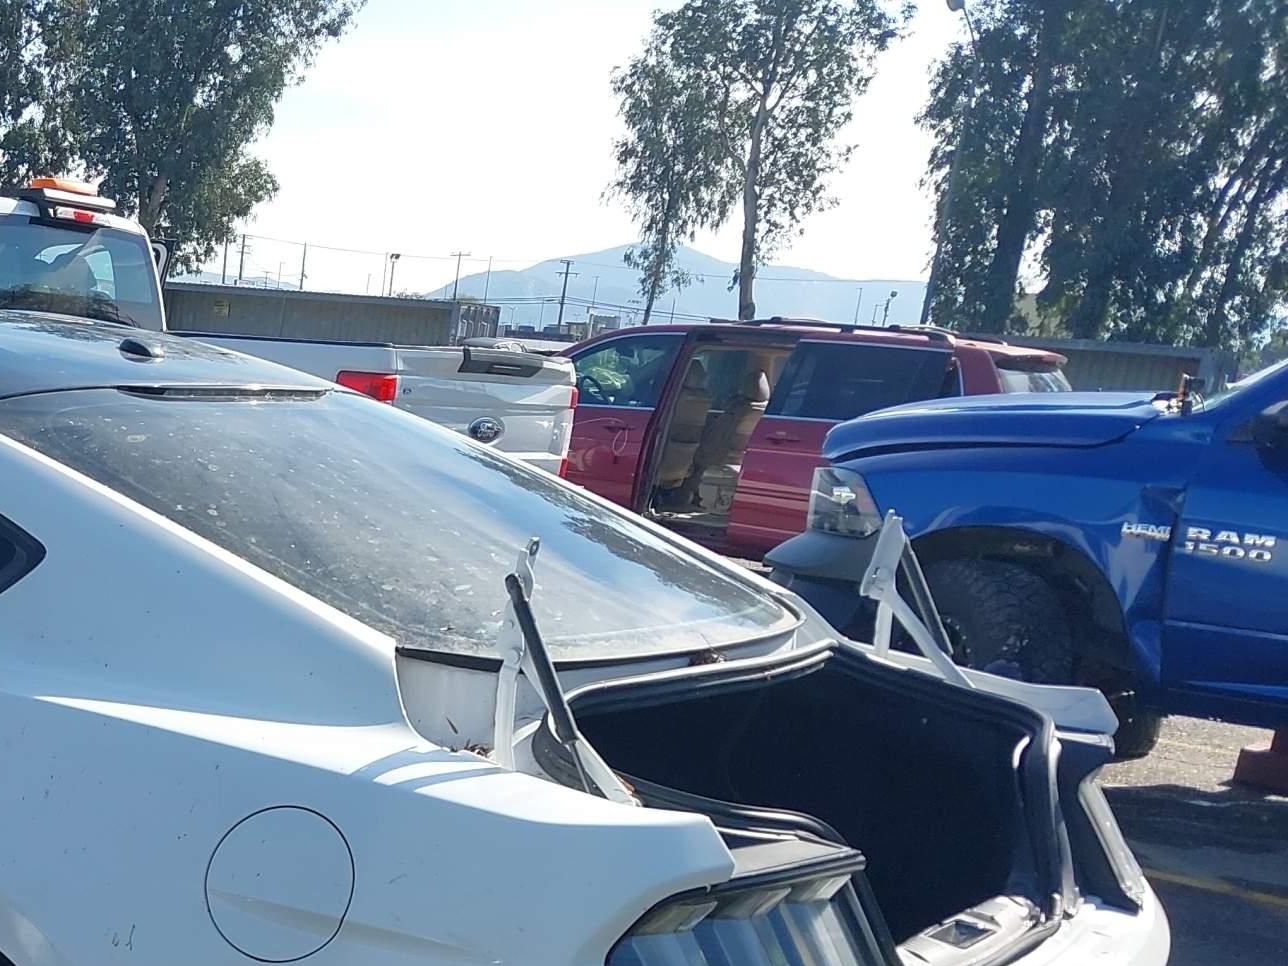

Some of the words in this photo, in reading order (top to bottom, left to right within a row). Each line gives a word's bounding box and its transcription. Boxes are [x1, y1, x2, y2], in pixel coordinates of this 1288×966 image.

[1121, 522, 1172, 542] HEMI
[1186, 526, 1277, 548] RAM
[1184, 541, 1273, 562] 1500
